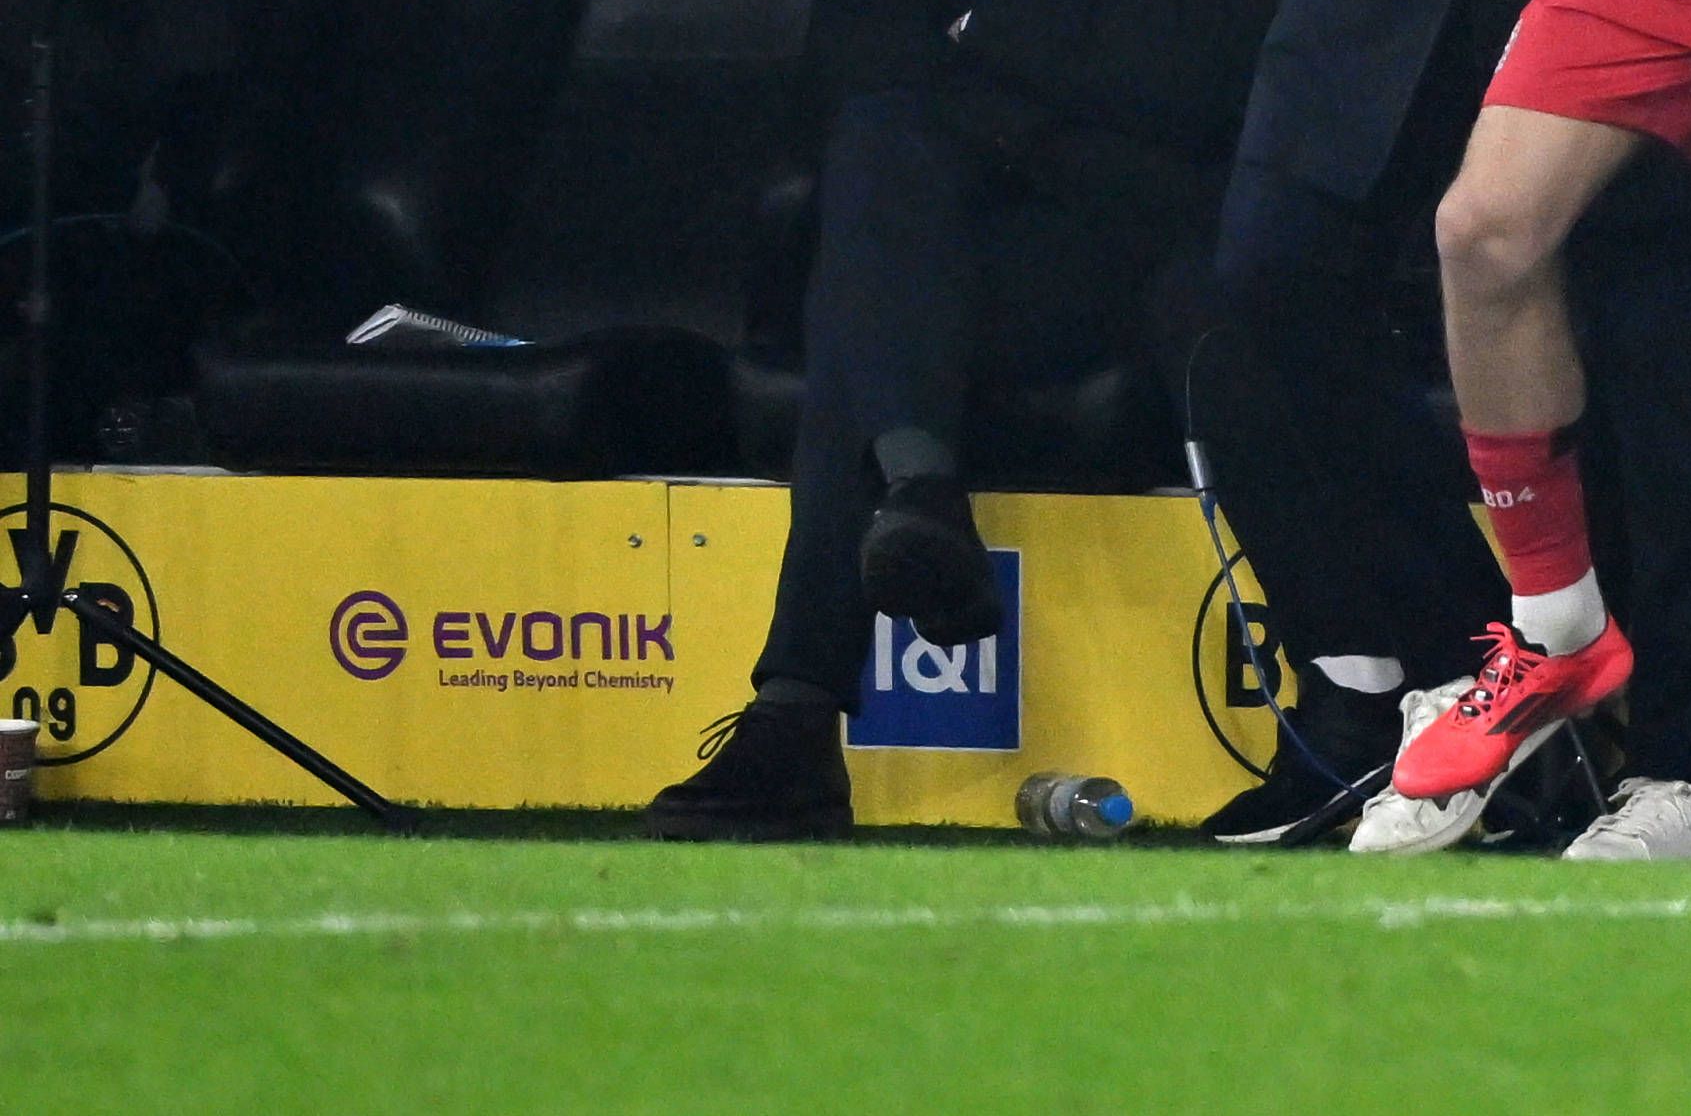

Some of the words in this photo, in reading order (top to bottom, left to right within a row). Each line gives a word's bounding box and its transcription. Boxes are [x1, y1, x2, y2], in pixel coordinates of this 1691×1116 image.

[433, 612, 674, 660] EVONIK
[439, 669, 508, 690] Leading
[513, 670, 578, 691] Beyond
[584, 670, 674, 693] Chemistry
